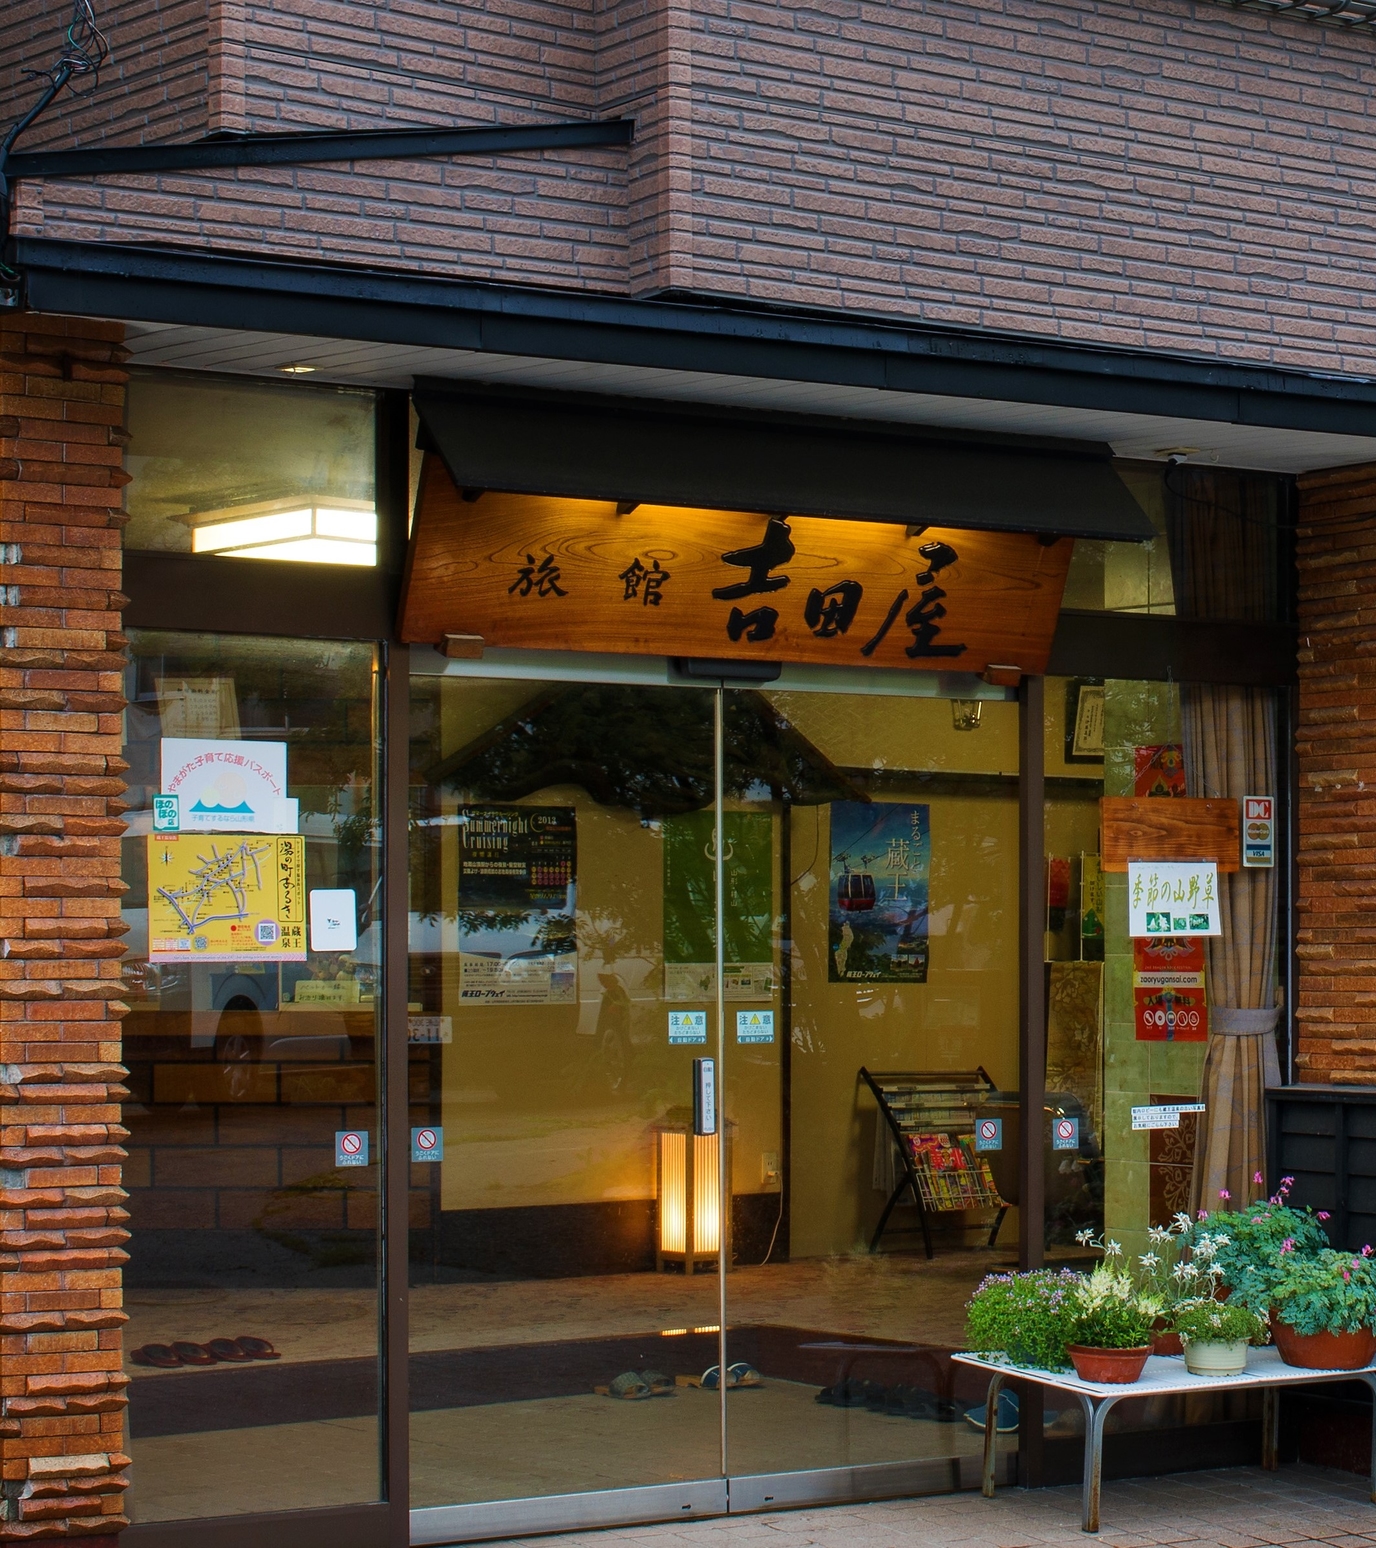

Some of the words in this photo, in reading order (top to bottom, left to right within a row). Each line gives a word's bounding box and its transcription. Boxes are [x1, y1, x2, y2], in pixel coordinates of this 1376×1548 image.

[168, 752, 281, 795] やまがた子育て応援パスポート
[192, 814, 255, 822] 子育てするなら山形県
[1248, 801, 1269, 818] DC
[280, 840, 295, 919] 湯の町あるき
[885, 838, 910, 901] 蔵王
[1132, 872, 1215, 910] 季節の山野草
[462, 989, 505, 998] 蔵王ロープウェイ
[1140, 976, 1198, 985] zaoryugansai.com
